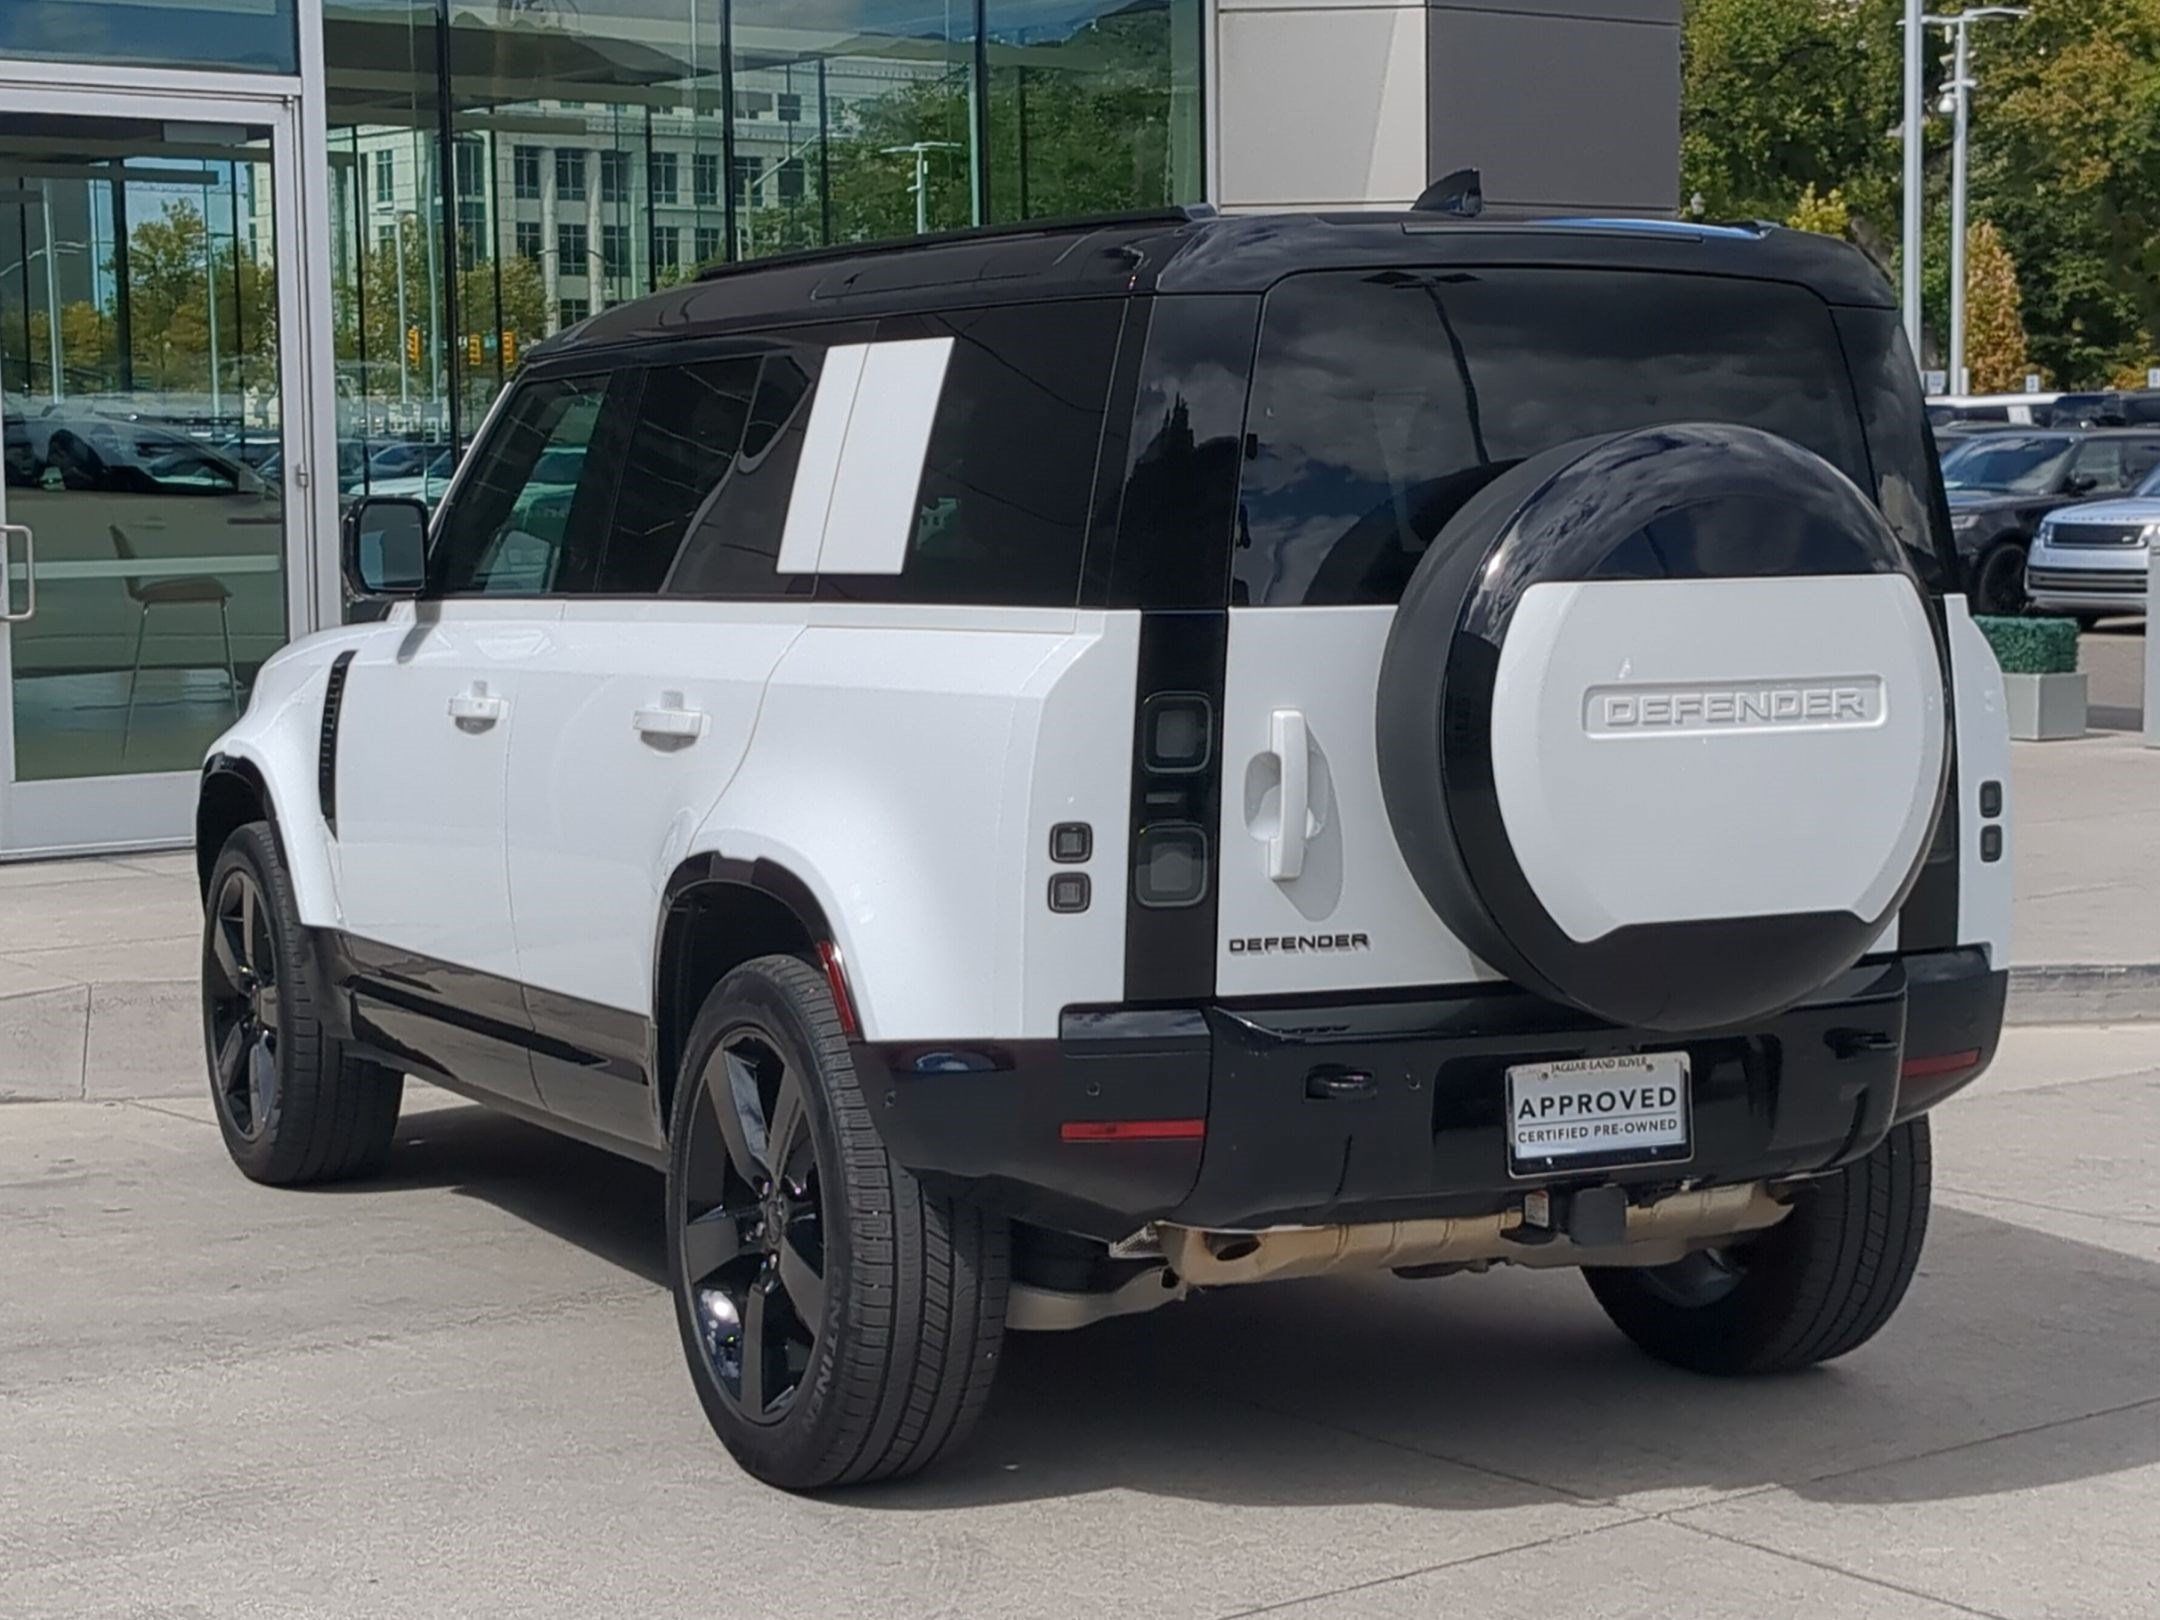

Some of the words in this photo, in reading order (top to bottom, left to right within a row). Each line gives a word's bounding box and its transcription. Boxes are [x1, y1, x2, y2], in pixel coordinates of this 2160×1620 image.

[1603, 687, 1864, 726] DEFENDER
[1229, 933, 1369, 952] DEFENDER
[1551, 1061, 1586, 1073] JAGUAR
[1589, 1059, 1616, 1070] LAND
[1517, 1086, 1677, 1120] APPROVED
[1518, 1126, 1589, 1144] CERTIFIED
[1594, 1118, 1678, 1136] PRE-OWNED
